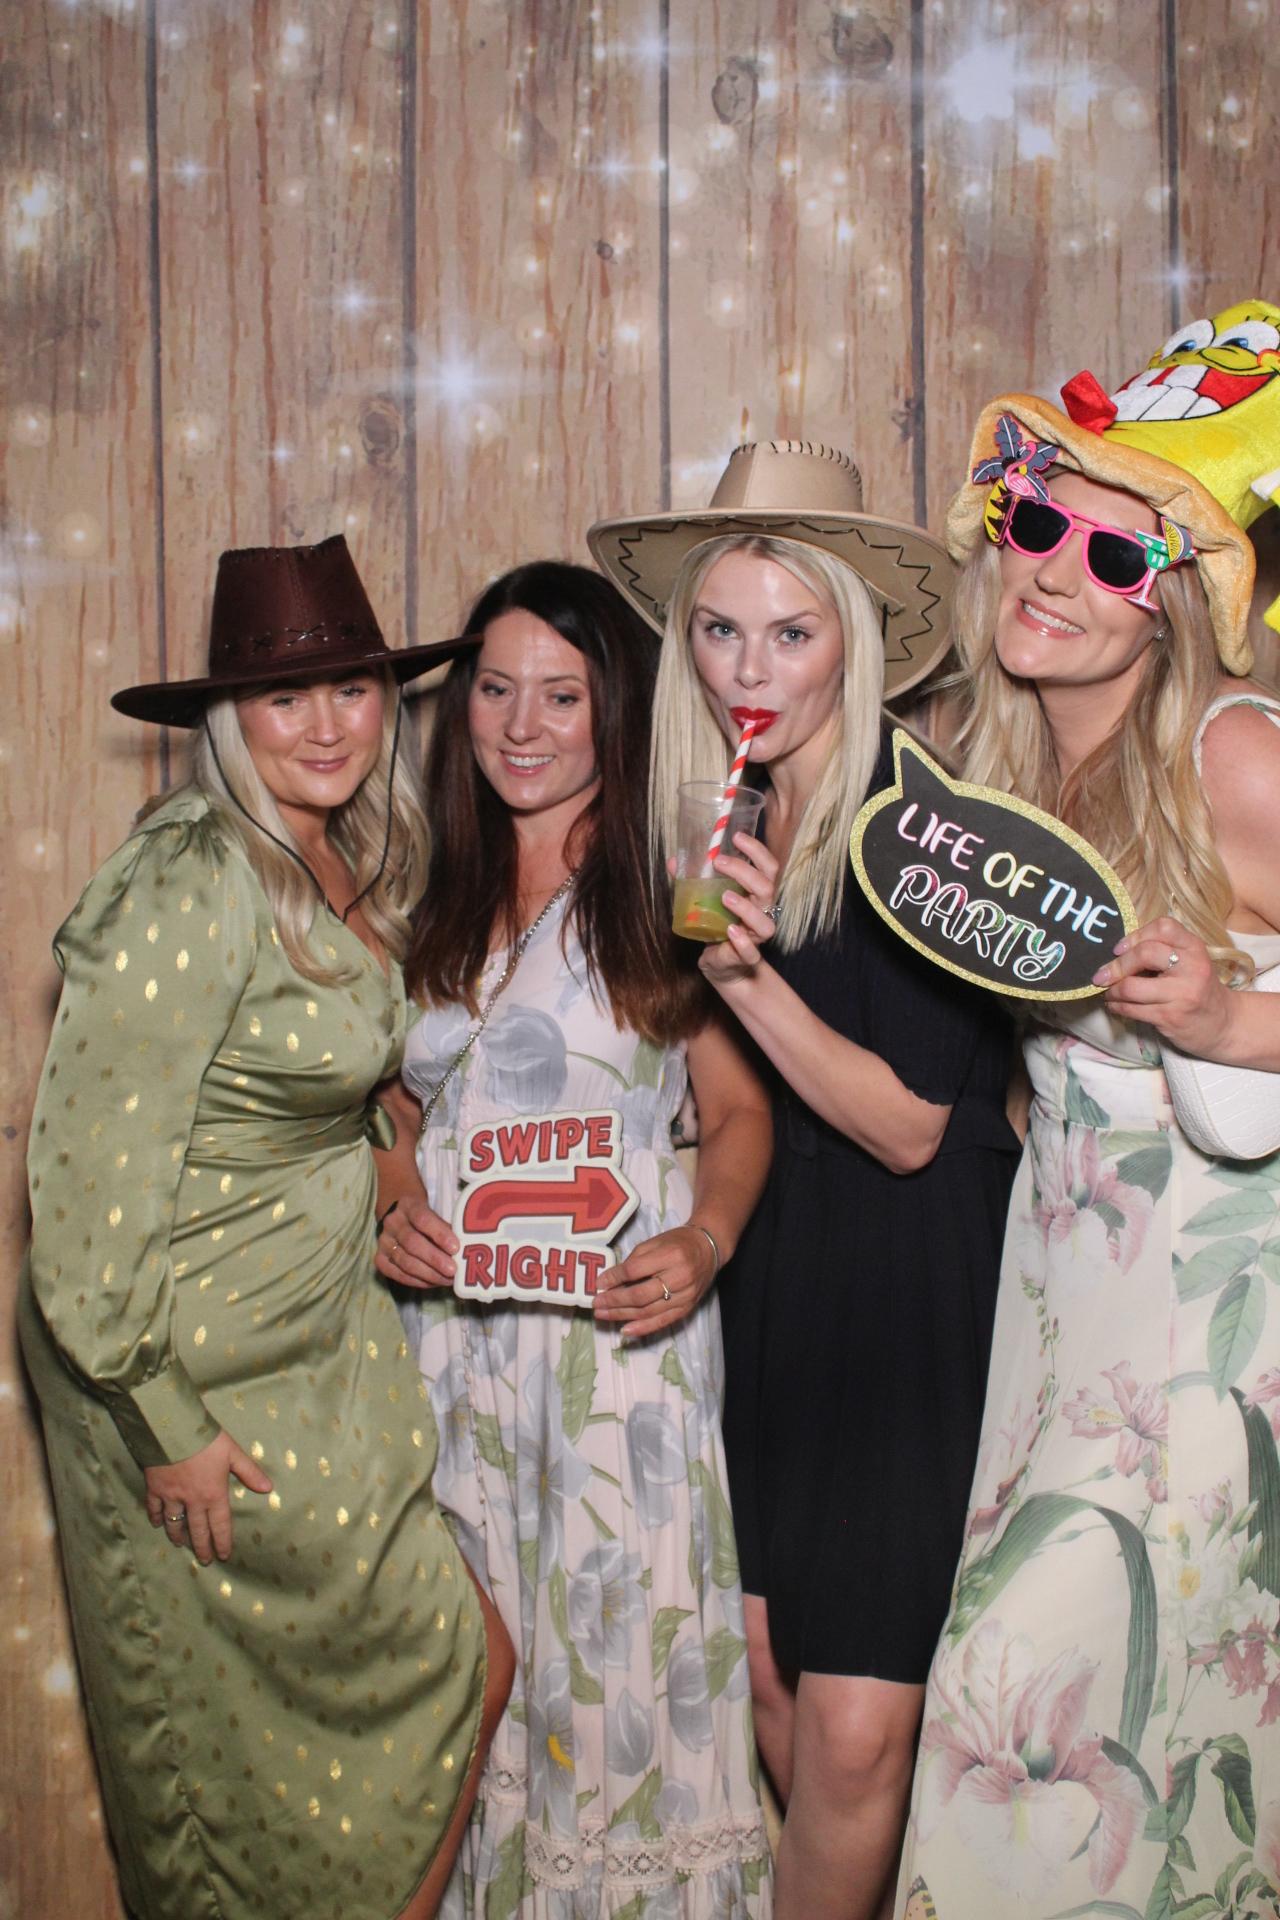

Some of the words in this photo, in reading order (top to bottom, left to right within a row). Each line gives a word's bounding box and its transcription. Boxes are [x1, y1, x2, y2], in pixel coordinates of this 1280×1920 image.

[897, 803, 985, 870] LIFE
[982, 852, 1044, 897] OF
[1040, 878, 1118, 943] THE
[889, 864, 1066, 981] PARTY
[469, 1116, 613, 1172] SWIPE
[463, 1244, 606, 1296] RIGHT
